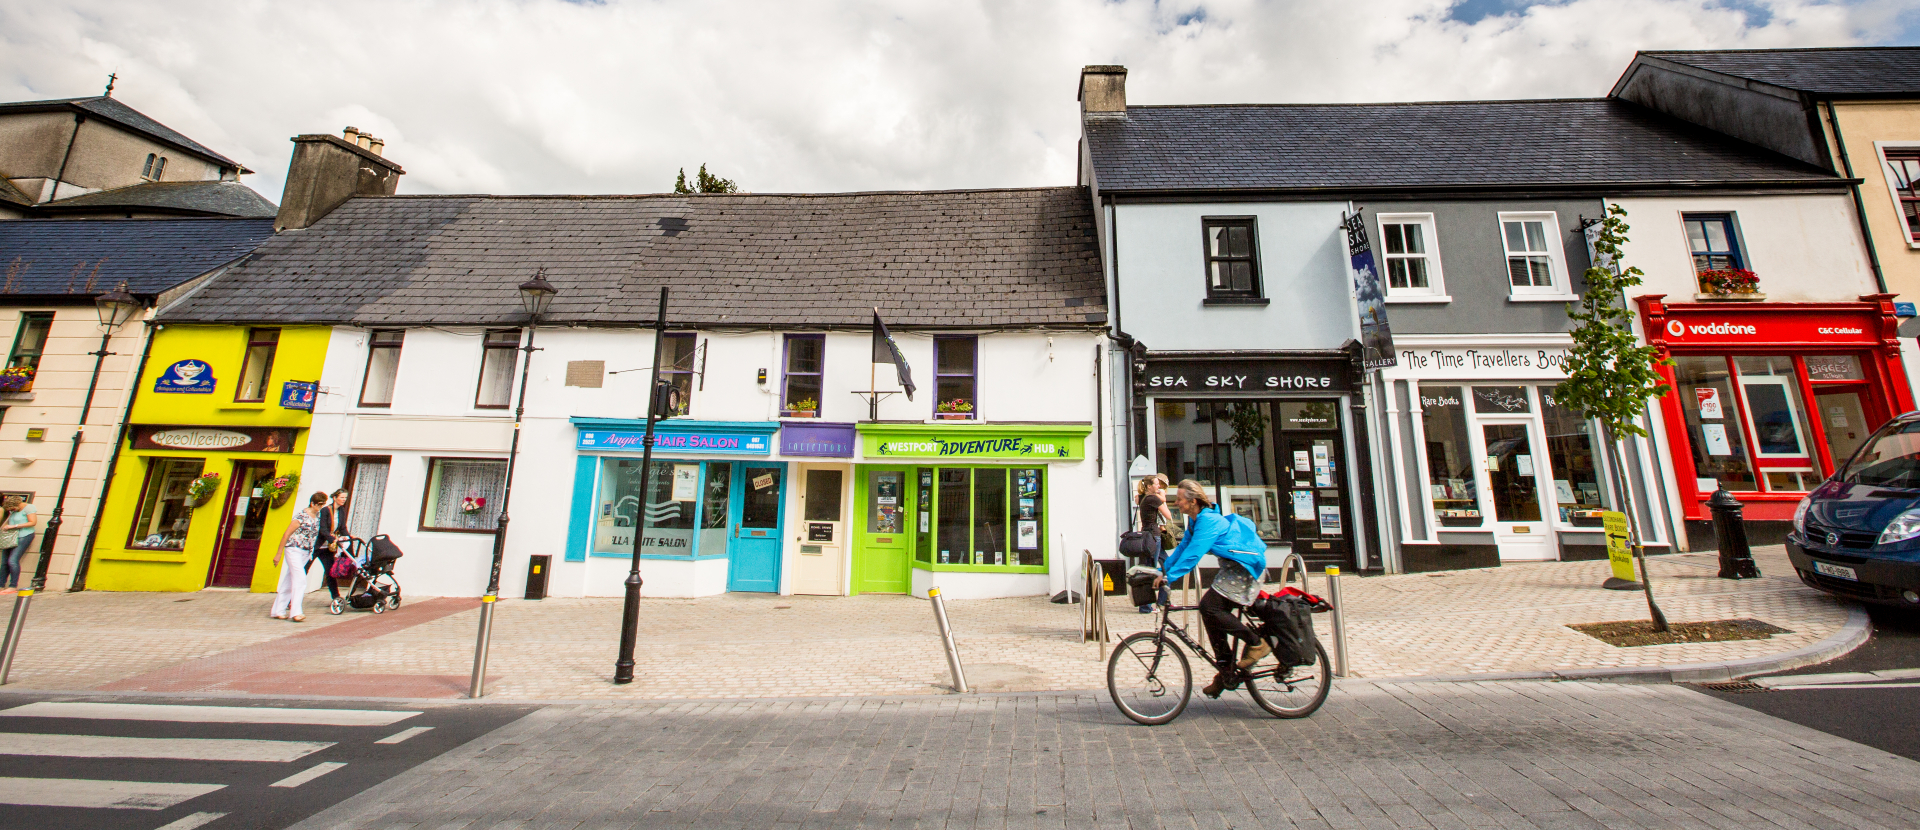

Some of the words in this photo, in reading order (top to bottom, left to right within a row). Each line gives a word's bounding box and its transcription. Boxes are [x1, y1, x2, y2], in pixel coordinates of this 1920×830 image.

[1347, 215, 1363, 233] SEA
[1349, 228, 1366, 247] SKY
[1351, 242, 1370, 256] SHORE
[1689, 322, 1757, 335] vodafone
[1834, 327, 1863, 335] Cellular
[1365, 357, 1396, 367] GALLERY
[1402, 350, 1428, 370] The
[1430, 350, 1464, 370] Time
[1466, 349, 1531, 369] Travellers
[1149, 375, 1188, 387] SEA
[1205, 375, 1247, 389] SKY
[1265, 376, 1331, 388] SHORE
[1421, 395, 1437, 407] Rare
[1437, 395, 1460, 407] Books
[155, 430, 247, 447] Recollections
[652, 434, 687, 447] HAIR
[689, 435, 740, 449] SALON
[788, 442, 847, 453] SOLICITORS
[887, 441, 938, 452] WESTPORT
[940, 438, 1022, 455] ADVENTURE
[1034, 443, 1056, 453] HUB
[754, 477, 772, 488] CLOSED
[658, 537, 688, 548] SALON
